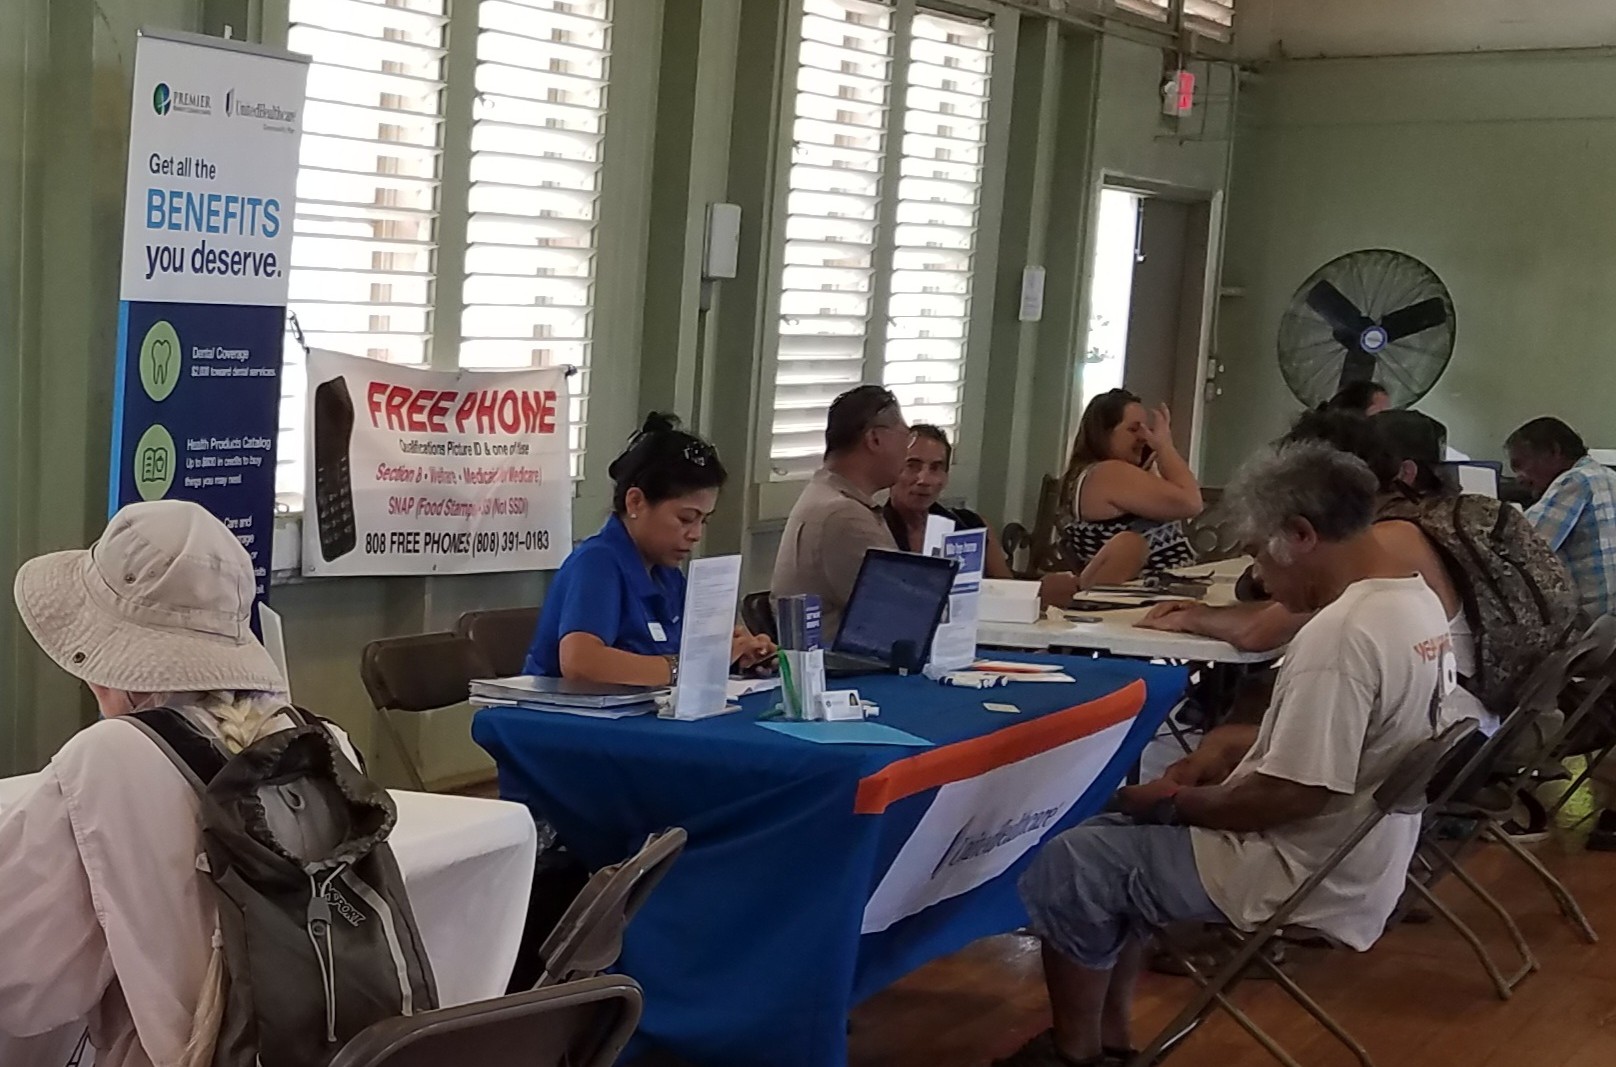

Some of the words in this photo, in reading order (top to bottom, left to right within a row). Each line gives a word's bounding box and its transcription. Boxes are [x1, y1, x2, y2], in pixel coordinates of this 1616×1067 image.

[173, 91, 211, 109] PREMIER
[149, 153, 174, 176] Get
[177, 157, 191, 178] all
[195, 159, 216, 180] the
[146, 188, 280, 238] BENEFITS
[145, 245, 185, 280] you
[191, 239, 282, 278] deserve.
[192, 346, 215, 359] Dental
[216, 346, 249, 362] Coverage
[367, 381, 459, 433] FREE
[455, 389, 557, 434] PHONE
[186, 438, 209, 451] Health
[210, 437, 242, 450] Products
[242, 436, 272, 451] Catalog
[400, 438, 446, 456] Qualifications
[447, 440, 472, 456] Picture
[474, 442, 483, 456] ID
[484, 442, 491, 456] &
[492, 444, 508, 456] one
[376, 462, 414, 483] Section
[388, 496, 415, 515] SNAP
[416, 497, 444, 519] (Food
[239, 515, 252, 527] and
[365, 532, 386, 555] 808
[389, 532, 420, 554] FREE
[424, 532, 471, 554] PHONES
[472, 531, 500, 558] (808)
[501, 530, 549, 552] 391-0183
